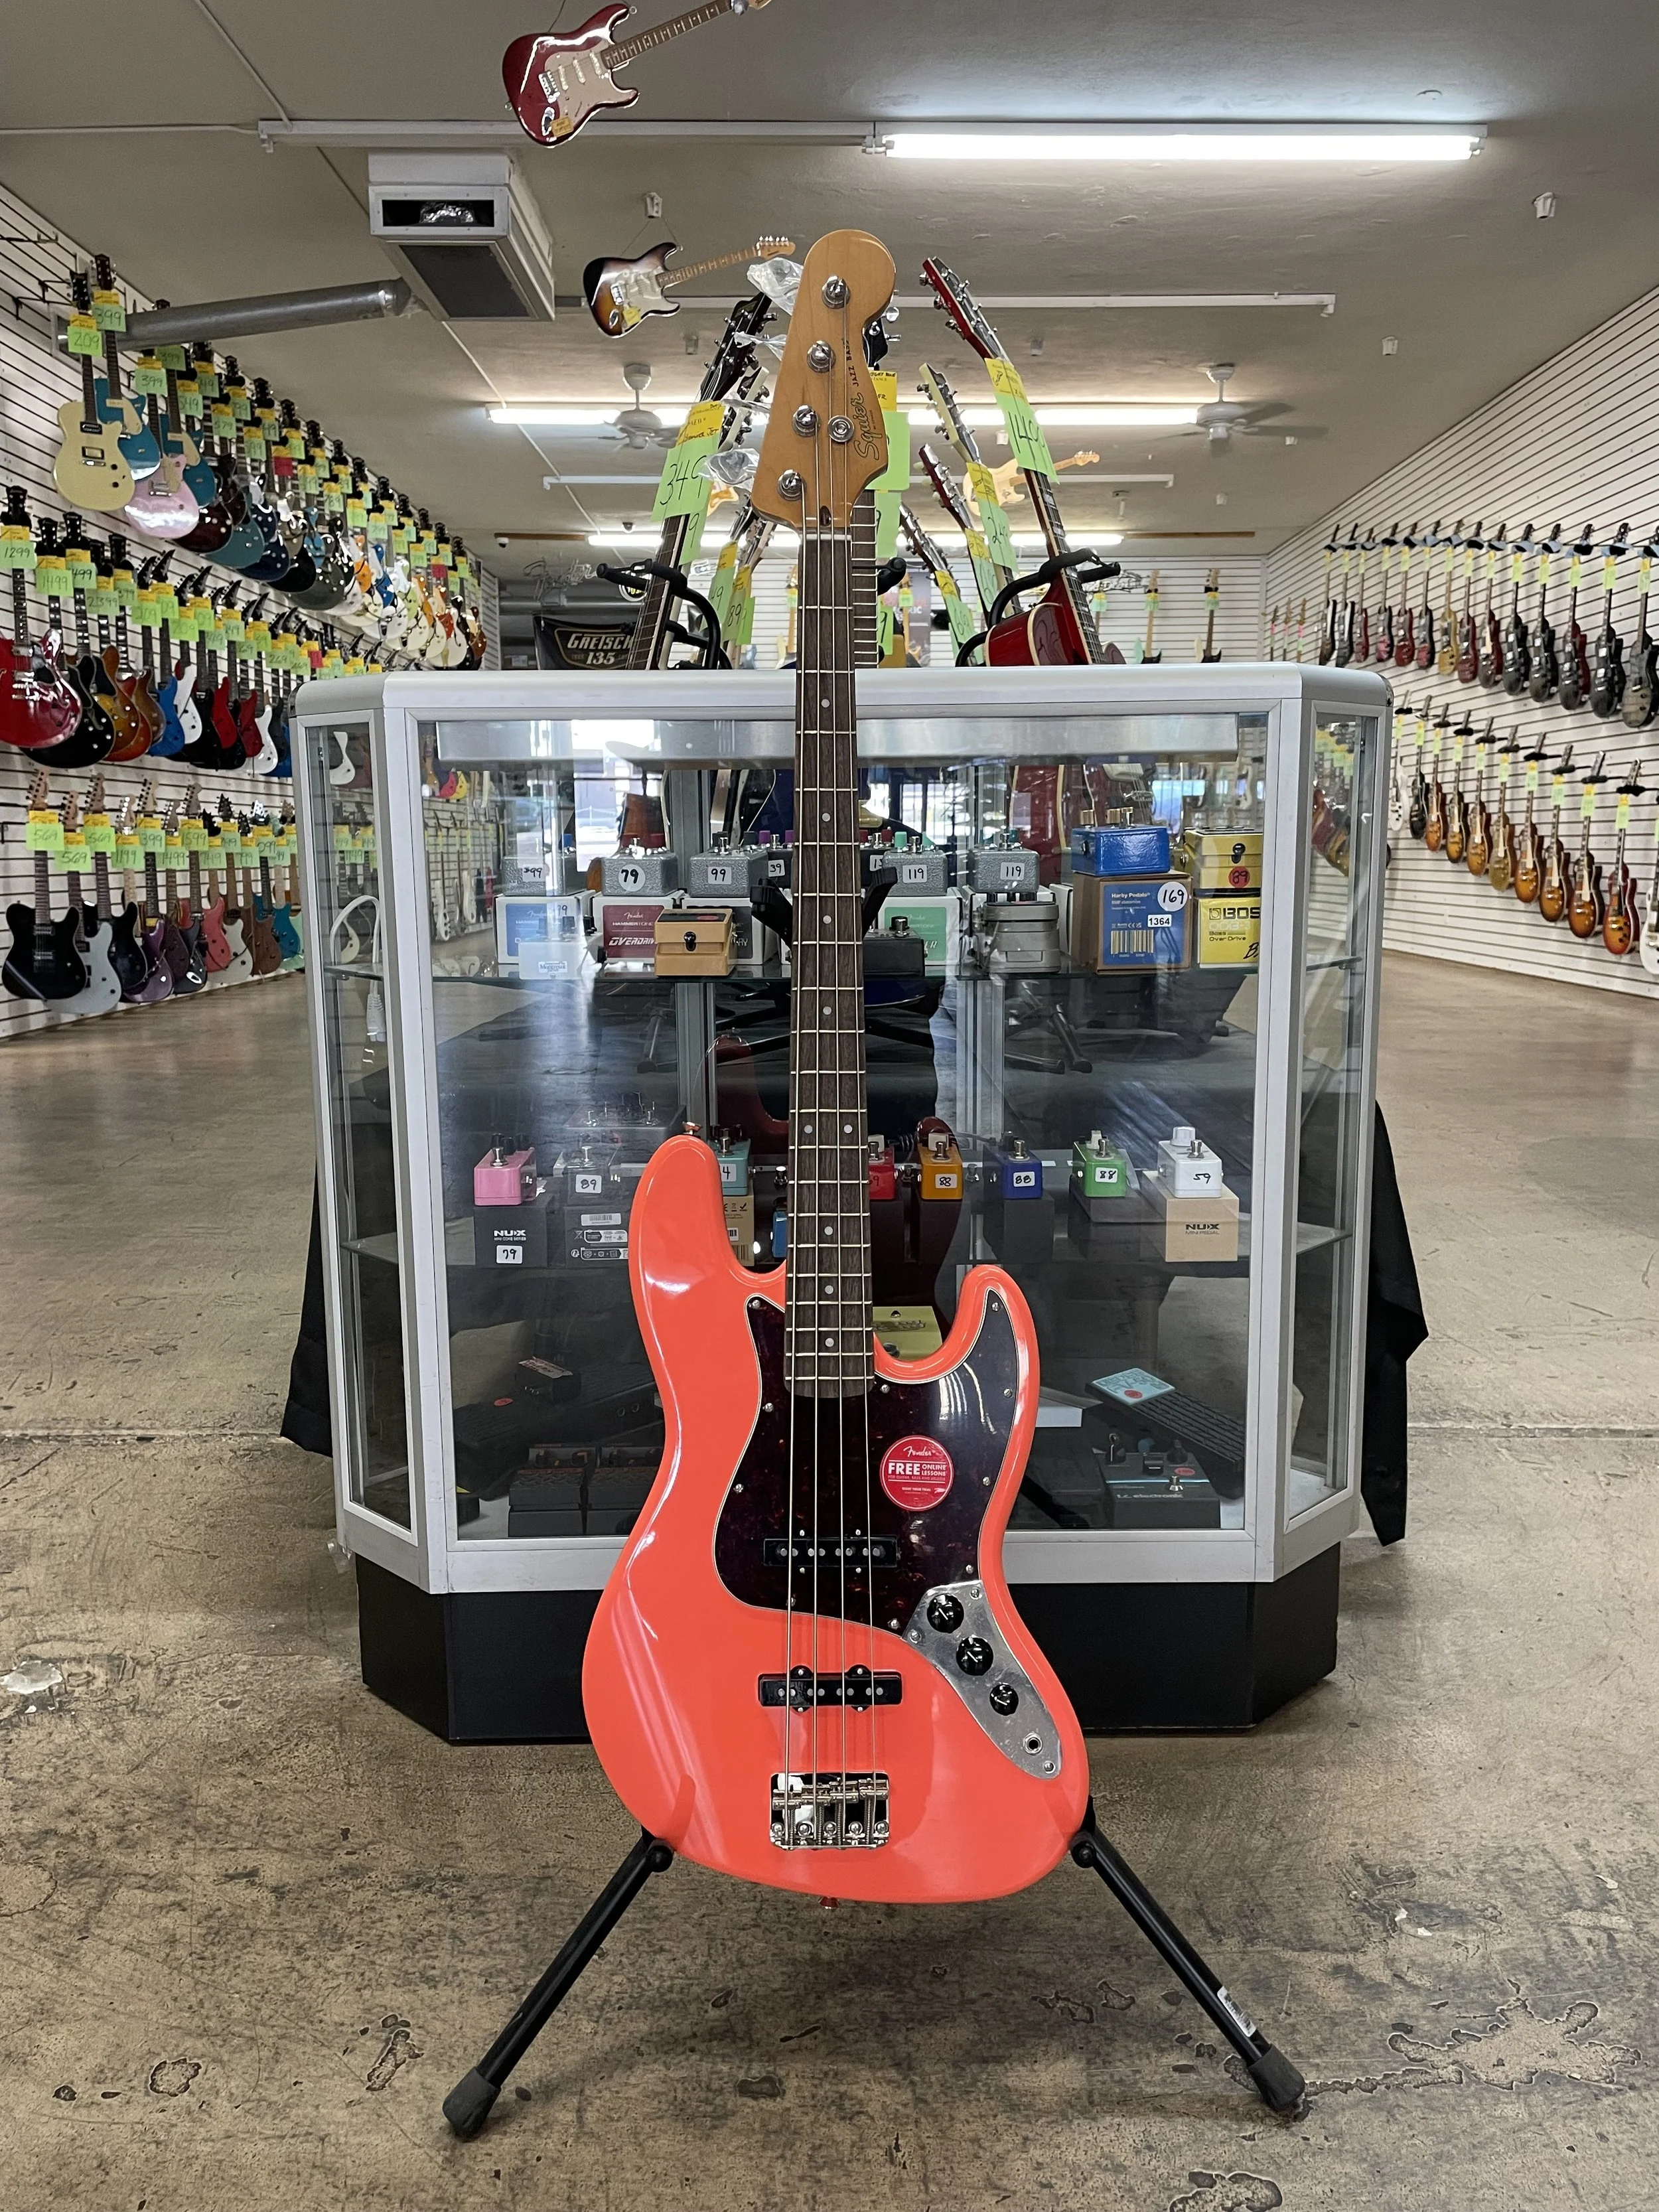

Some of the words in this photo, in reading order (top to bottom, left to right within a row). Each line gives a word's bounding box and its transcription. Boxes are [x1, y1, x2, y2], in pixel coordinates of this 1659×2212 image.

[95, 307, 122, 327] 399
[74, 332, 100, 350] 209
[141, 375, 163, 388] 399
[848, 366, 859, 387] JAZZ
[851, 392, 883, 461] Squier
[660, 455, 707, 505] 349
[4, 546, 31, 558] 1299
[72, 569, 92, 581] 499
[42, 575, 68, 590] 1499
[586, 652, 616, 665] 135
[33, 830, 58, 842] 569
[62, 850, 88, 864] 569
[162, 851, 186, 866] 1499
[711, 868, 727, 882] 99
[769, 863, 782, 874] 39
[908, 868, 924, 880] 119
[1006, 865, 1021, 877] 119
[621, 869, 639, 884] 79
[1232, 870, 1248, 884] 89
[1163, 889, 1185, 905] 169
[624, 910, 644, 920] Fender
[1222, 907, 1261, 920] BOS
[609, 936, 654, 946] OVERDRIV
[722, 1165, 731, 1180] 4
[1193, 1173, 1212, 1185] 59
[580, 1179, 597, 1191] 89
[939, 1176, 952, 1187] 88
[1015, 1175, 1032, 1185] 88
[502, 1248, 517, 1260] 79
[902, 1445, 932, 1457] Fender
[888, 1462, 920, 1475] FREE
